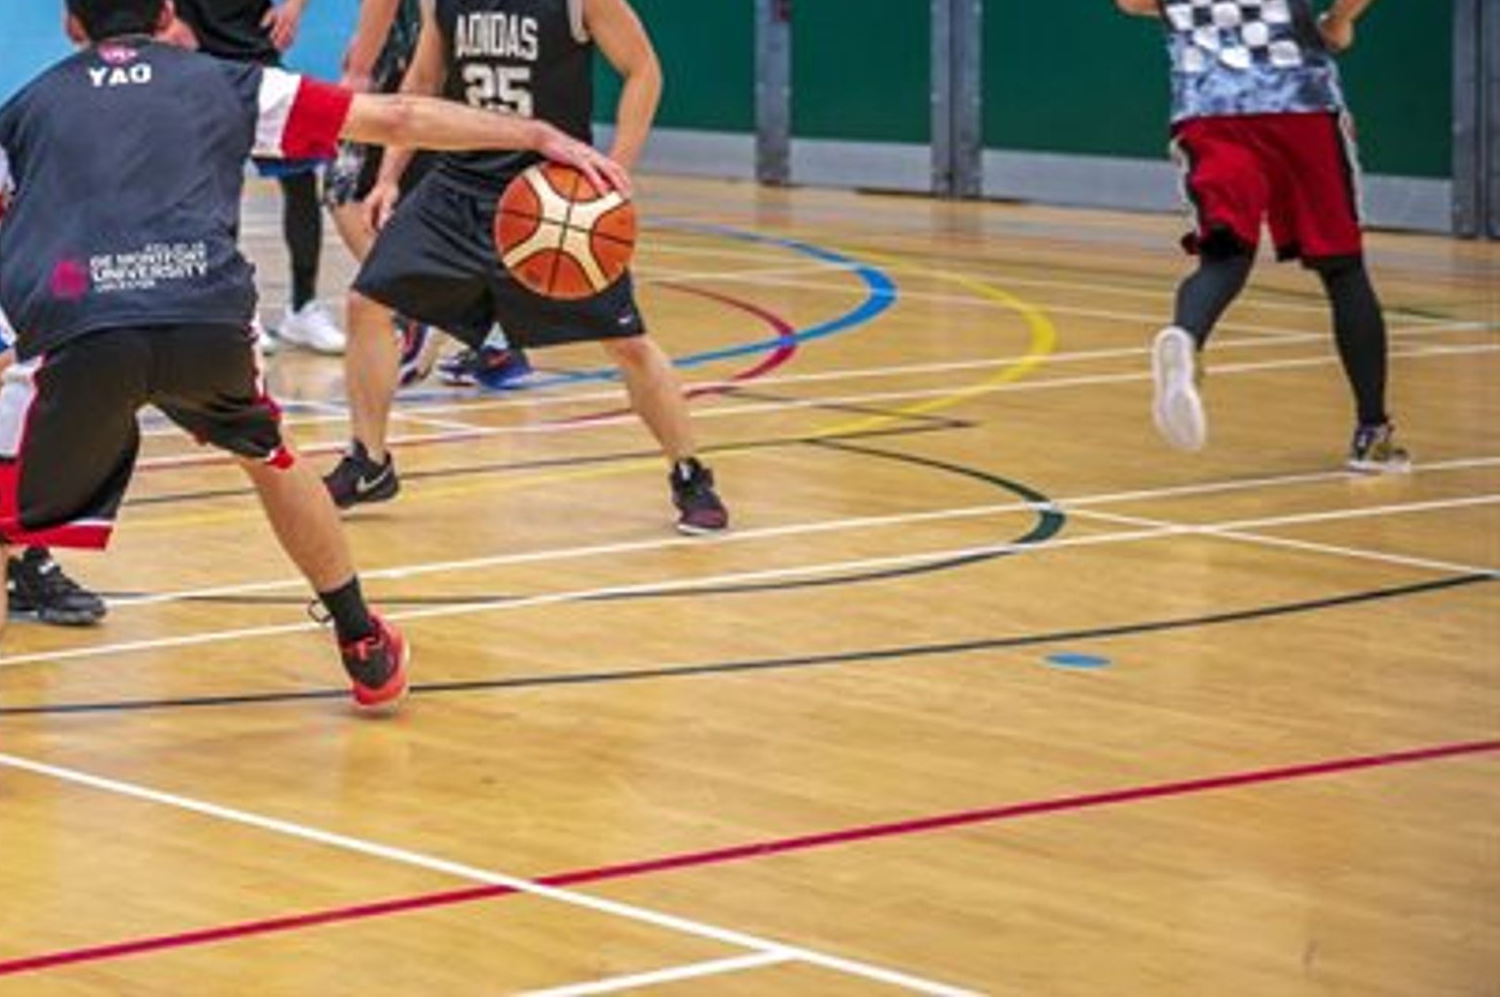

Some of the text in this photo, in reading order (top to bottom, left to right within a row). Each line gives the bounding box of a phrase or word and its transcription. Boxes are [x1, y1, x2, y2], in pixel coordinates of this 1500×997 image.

[455, 12, 538, 61] ADIDAS
[88, 63, 152, 87] YAO
[461, 62, 534, 118] 25
[92, 260, 207, 281] UNIVERSITY
